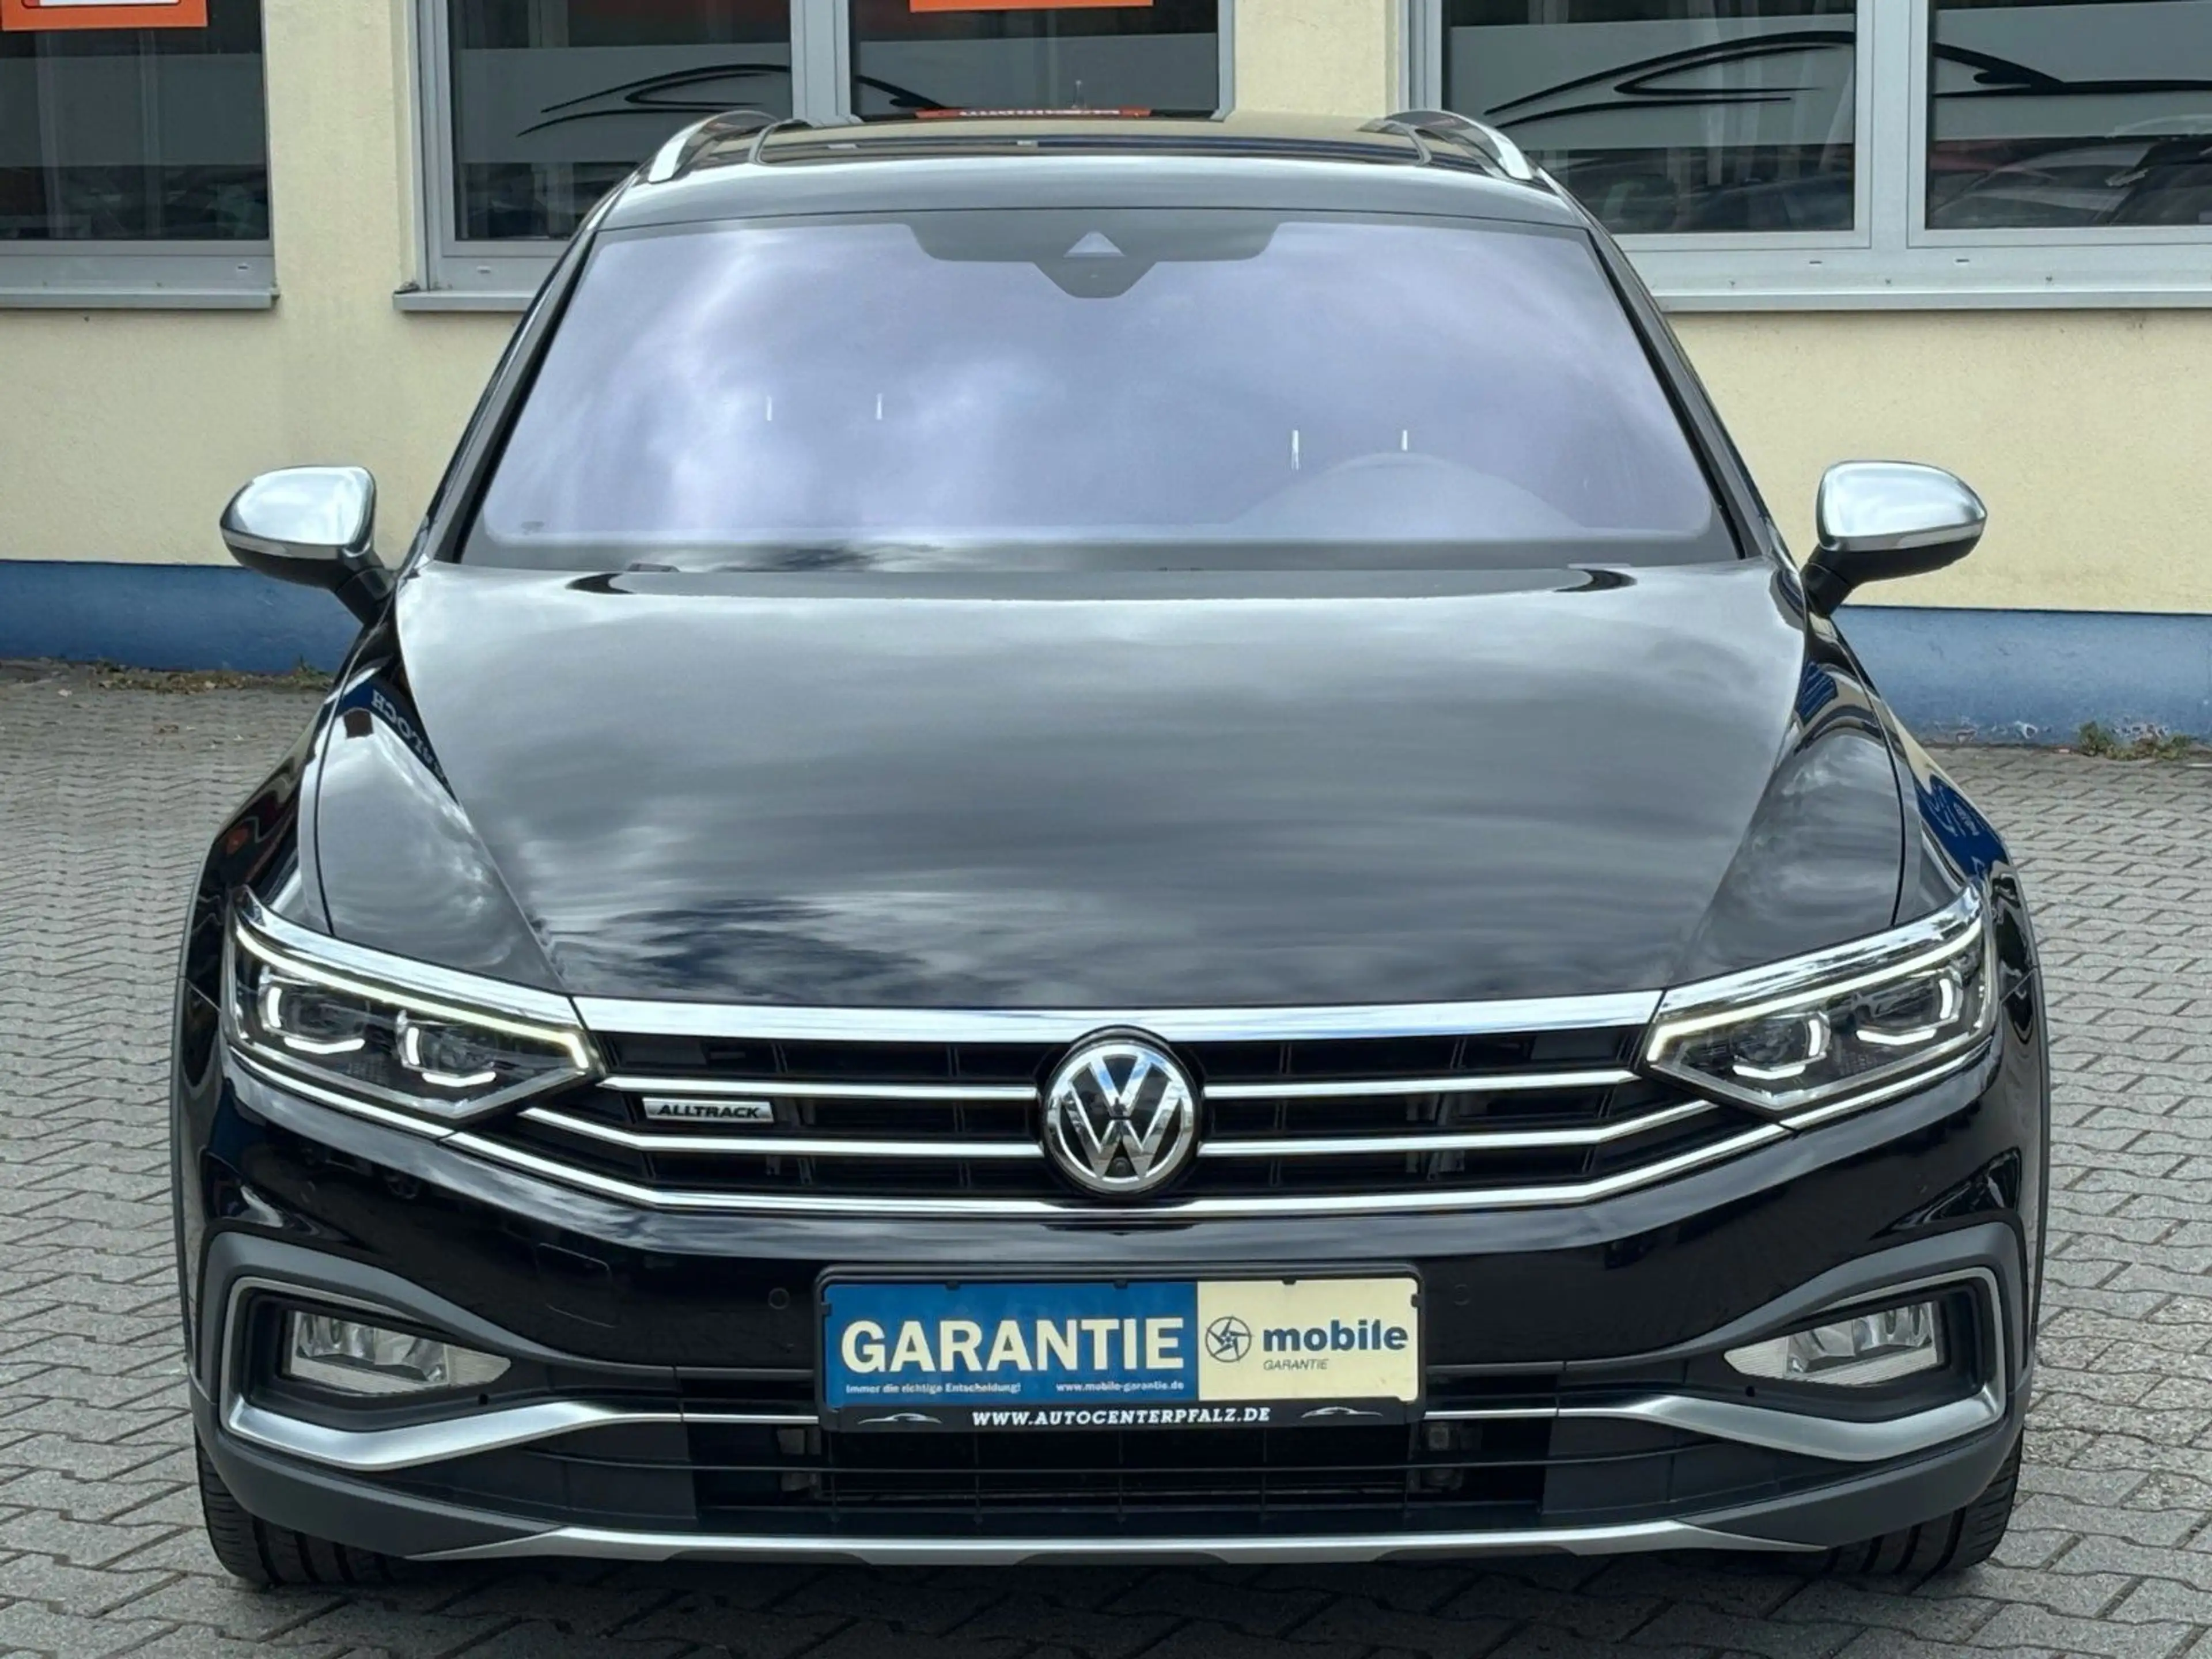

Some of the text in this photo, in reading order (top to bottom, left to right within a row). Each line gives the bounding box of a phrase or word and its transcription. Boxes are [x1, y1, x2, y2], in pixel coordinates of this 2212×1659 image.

[657, 1104, 760, 1119] ALLTRACK
[1052, 1048, 1189, 1187] VW
[1263, 1319, 1408, 1351] mobile
[842, 1318, 1184, 1373] GARANTIE
[1263, 1358, 1330, 1371] GARANTIE
[846, 1382, 1022, 1395] Immer die richtige Entscheidung!
[1056, 1380, 1184, 1392] www.mobile-garantie.de
[972, 1408, 1270, 1426] WWW.AUTOCENTERPFALZ.DE
